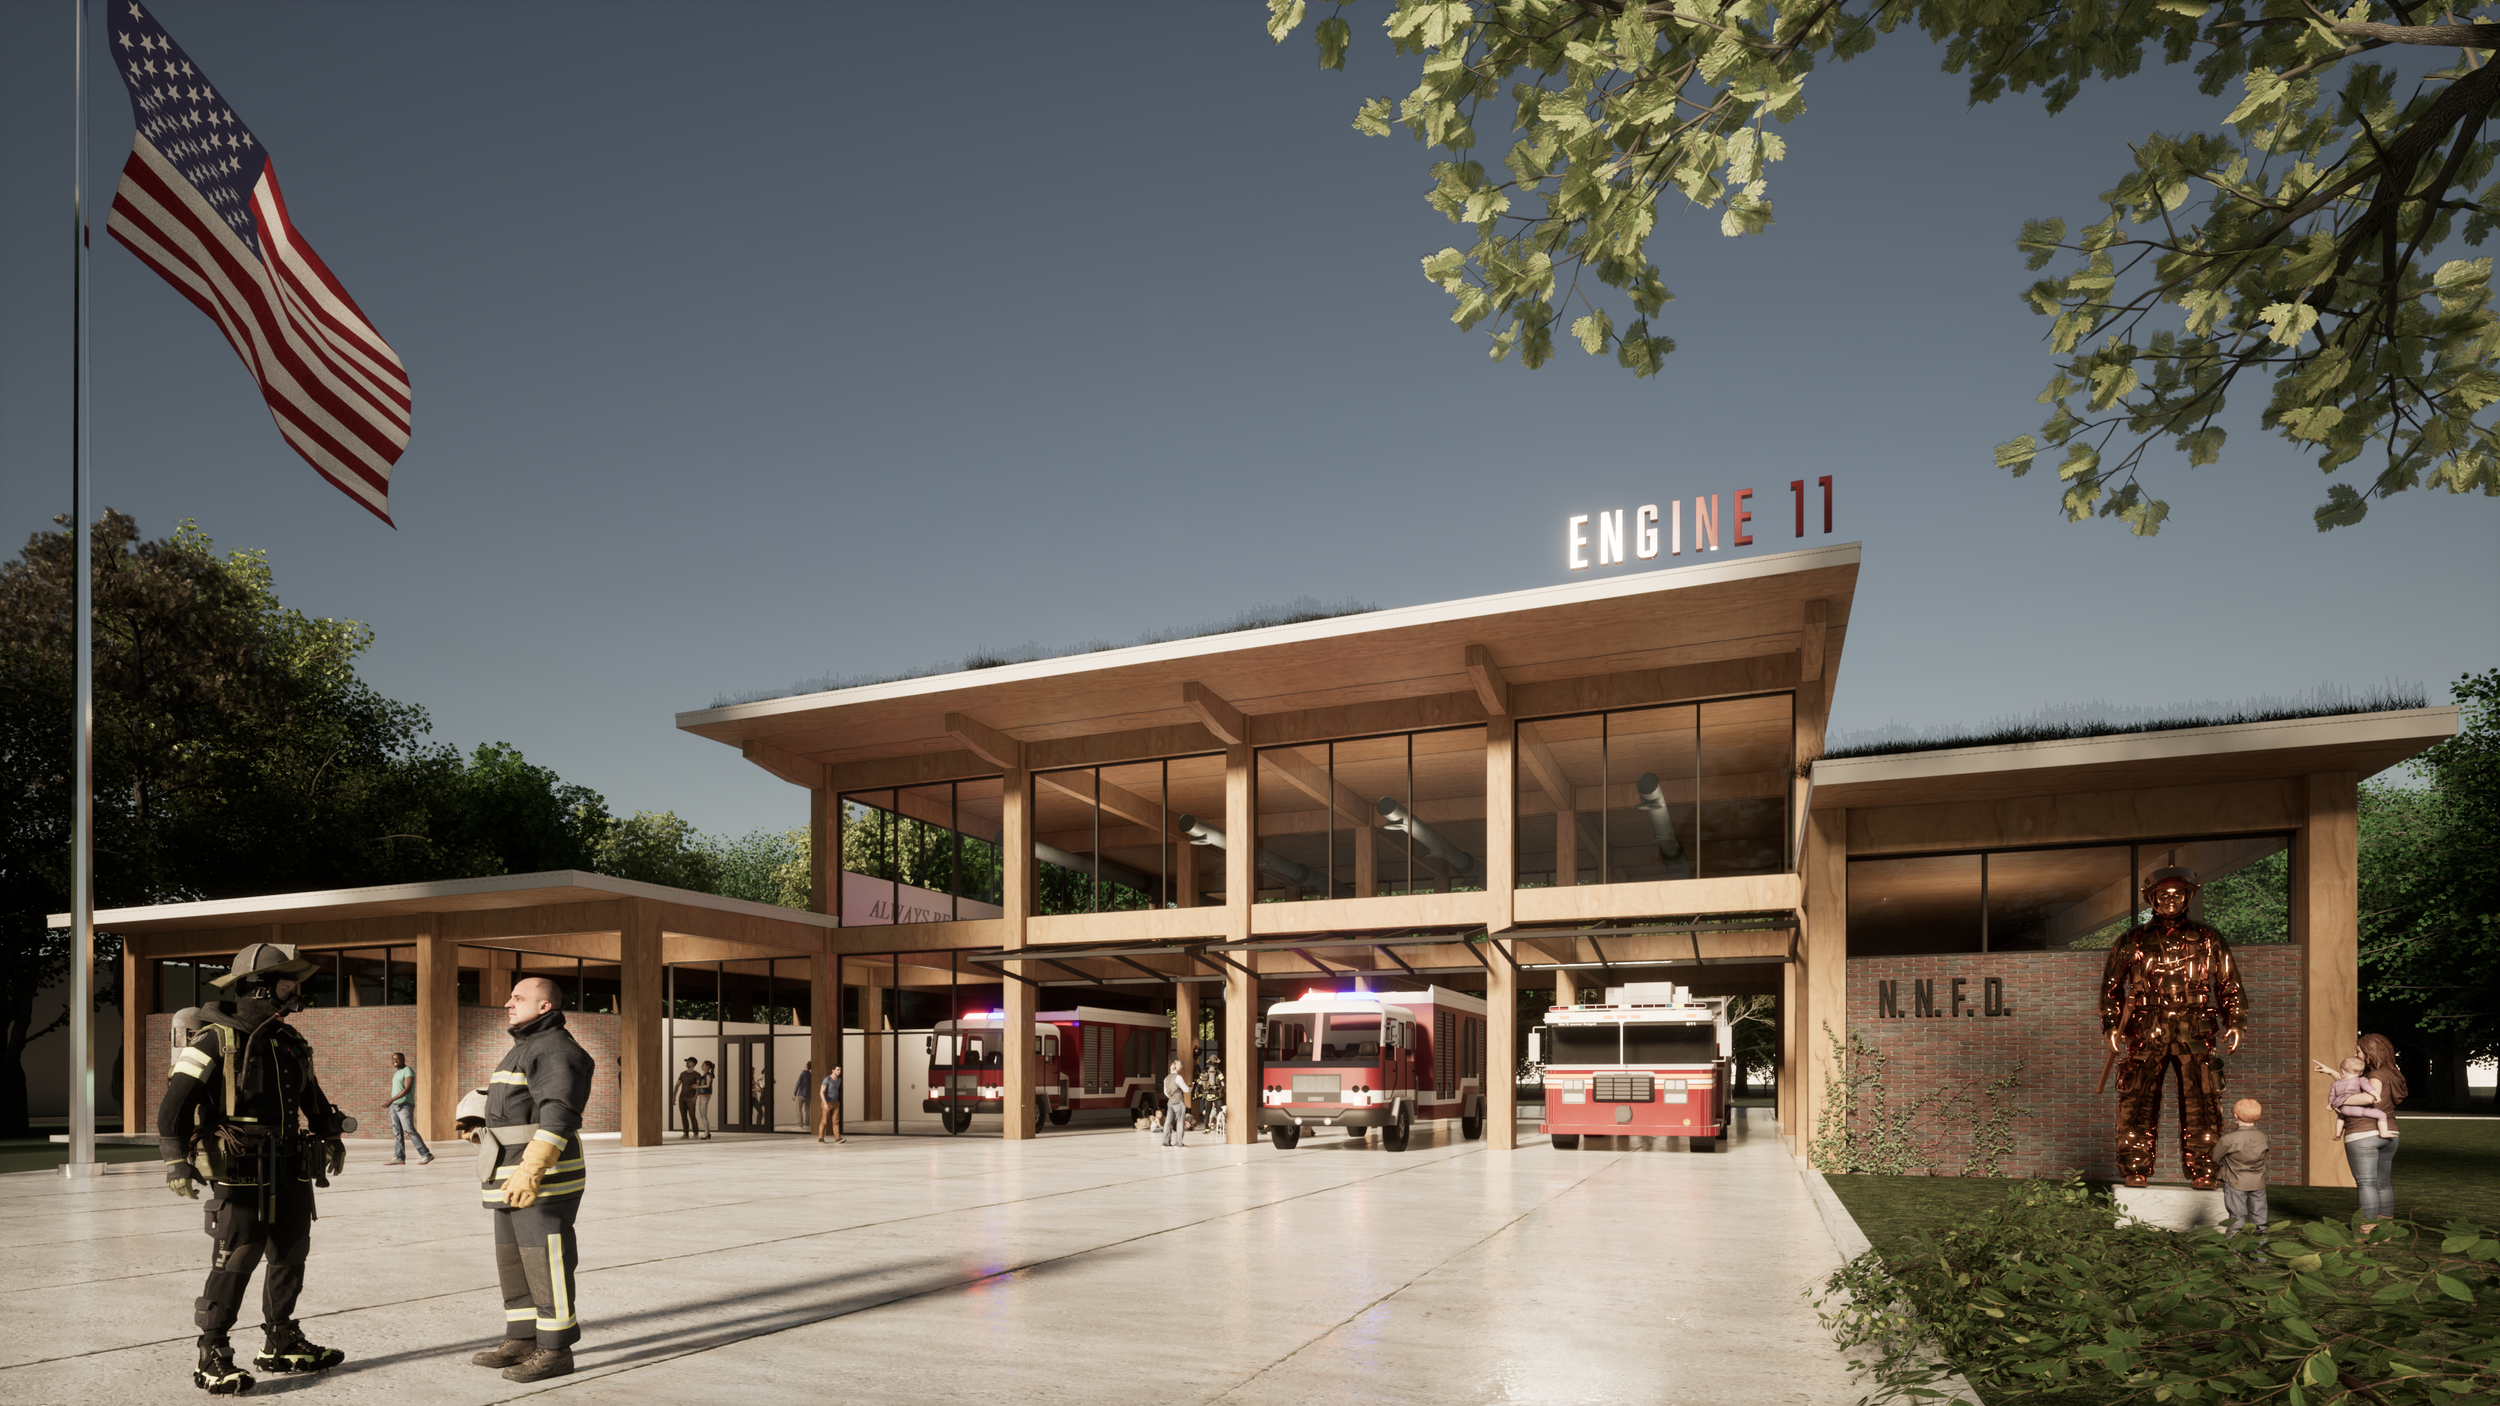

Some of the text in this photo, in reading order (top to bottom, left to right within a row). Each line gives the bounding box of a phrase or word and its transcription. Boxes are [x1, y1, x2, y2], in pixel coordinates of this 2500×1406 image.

[1569, 474, 1833, 571] ENGINE 11
[868, 899, 930, 923] ALWAYS
[1879, 976, 2012, 1018] N.N.F.D.
